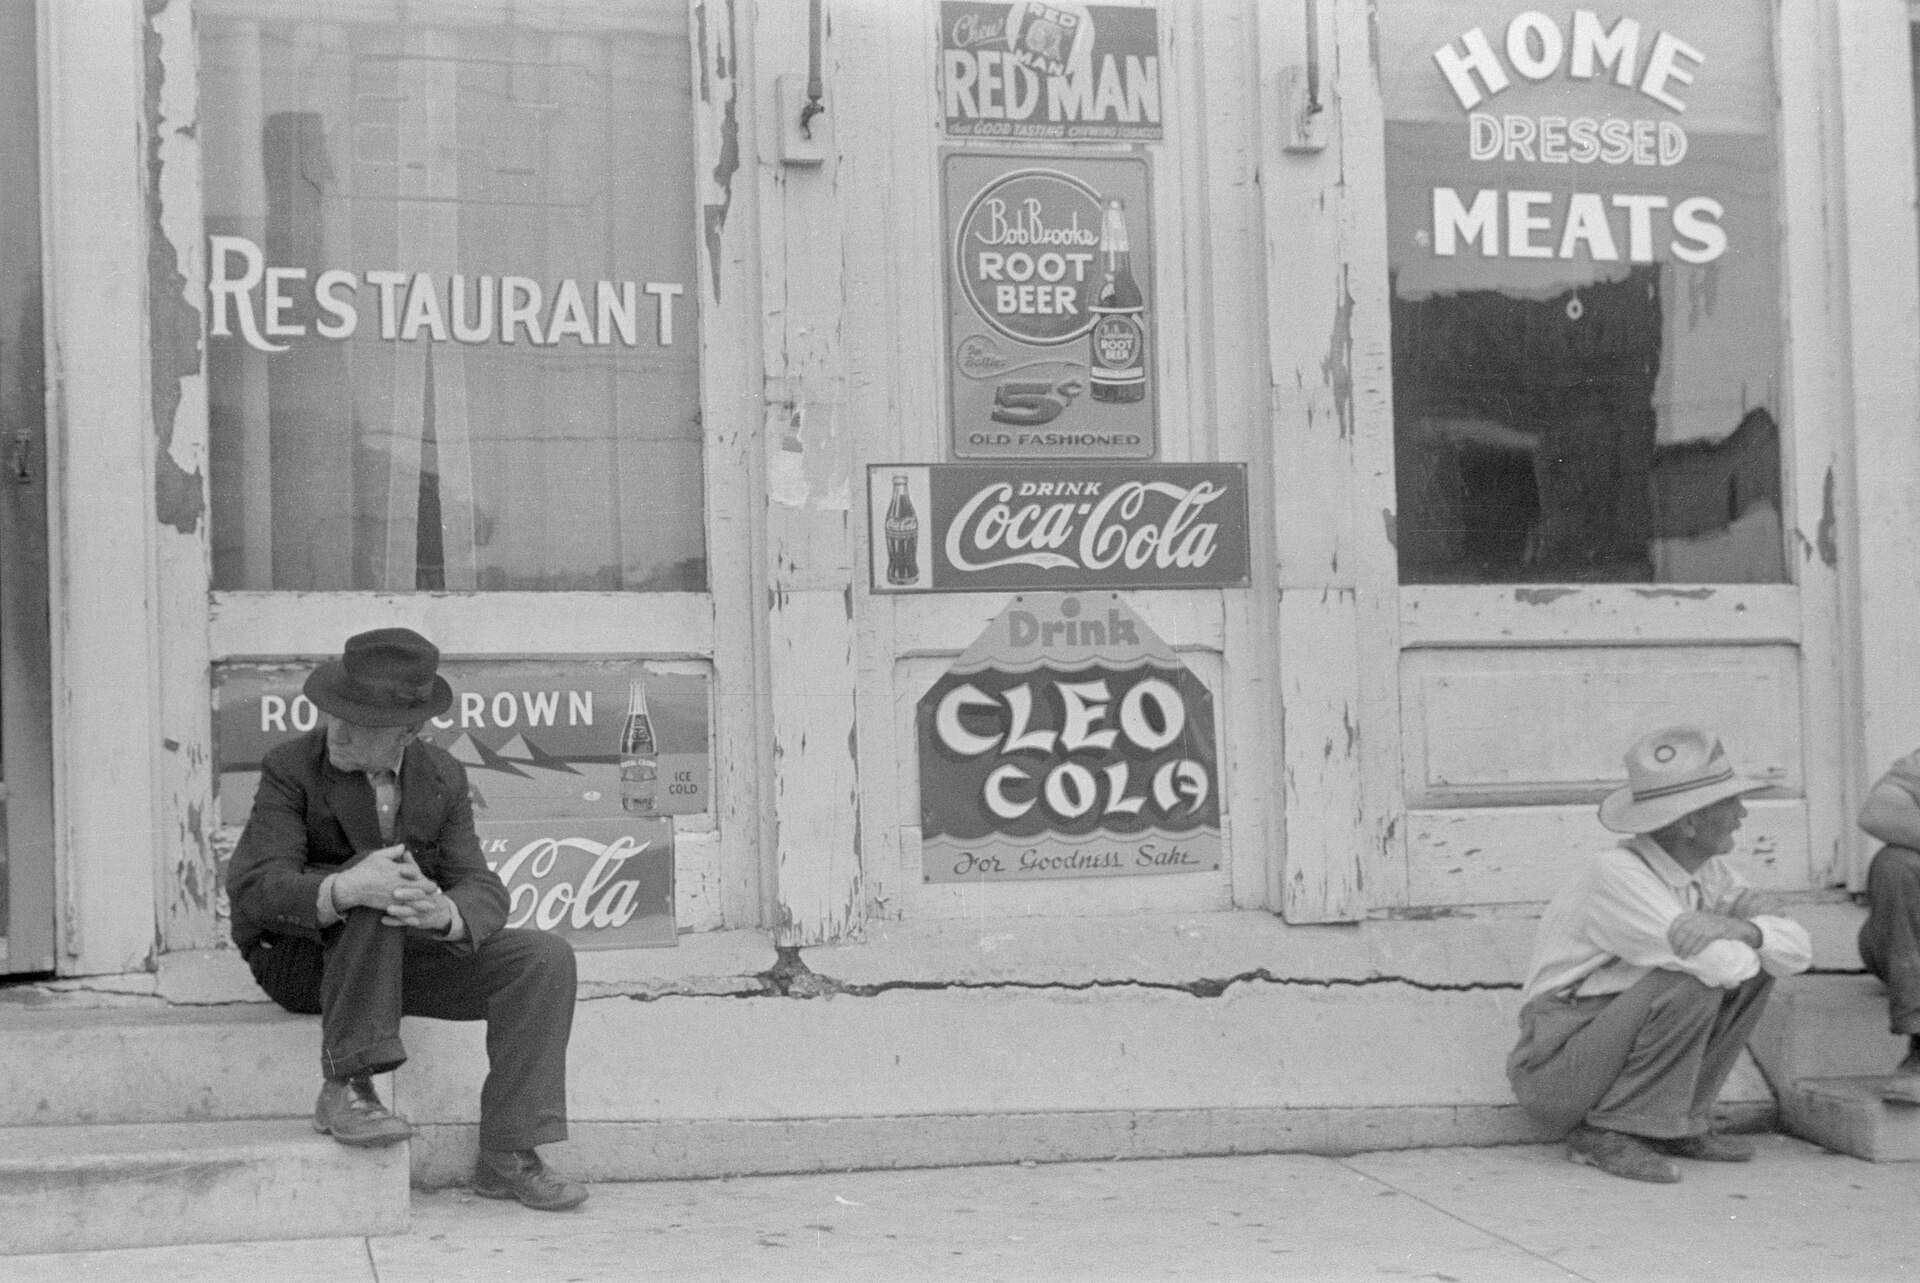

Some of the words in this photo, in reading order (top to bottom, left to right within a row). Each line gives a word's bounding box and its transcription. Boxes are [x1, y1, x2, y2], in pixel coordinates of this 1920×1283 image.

[1434, 9, 1704, 113] HOME
[945, 50, 1039, 120] RED
[1047, 53, 1160, 122] MAN
[974, 121, 1011, 135] GOOD
[1469, 112, 1688, 166] DRESSED
[976, 198, 1028, 245] Bob
[1024, 198, 1099, 246] Brooks
[1433, 187, 1727, 264] MEATS
[979, 251, 1093, 282] ROOT
[208, 235, 684, 352] RESTAURANT
[997, 285, 1078, 315] BEER
[1101, 339, 1132, 350] ROOT
[969, 433, 1010, 445] OLD
[1018, 433, 1141, 445] FASHIONED
[1019, 482, 1102, 496] DRINK
[1008, 597, 1140, 648] Drink
[936, 680, 1184, 755] CLEO
[669, 784, 698, 795] COLD
[674, 771, 692, 782] ICE
[983, 761, 1208, 818] COLA
[954, 852, 1005, 875] For
[1019, 849, 1124, 872] Goodness
[1135, 844, 1200, 867] Sake
